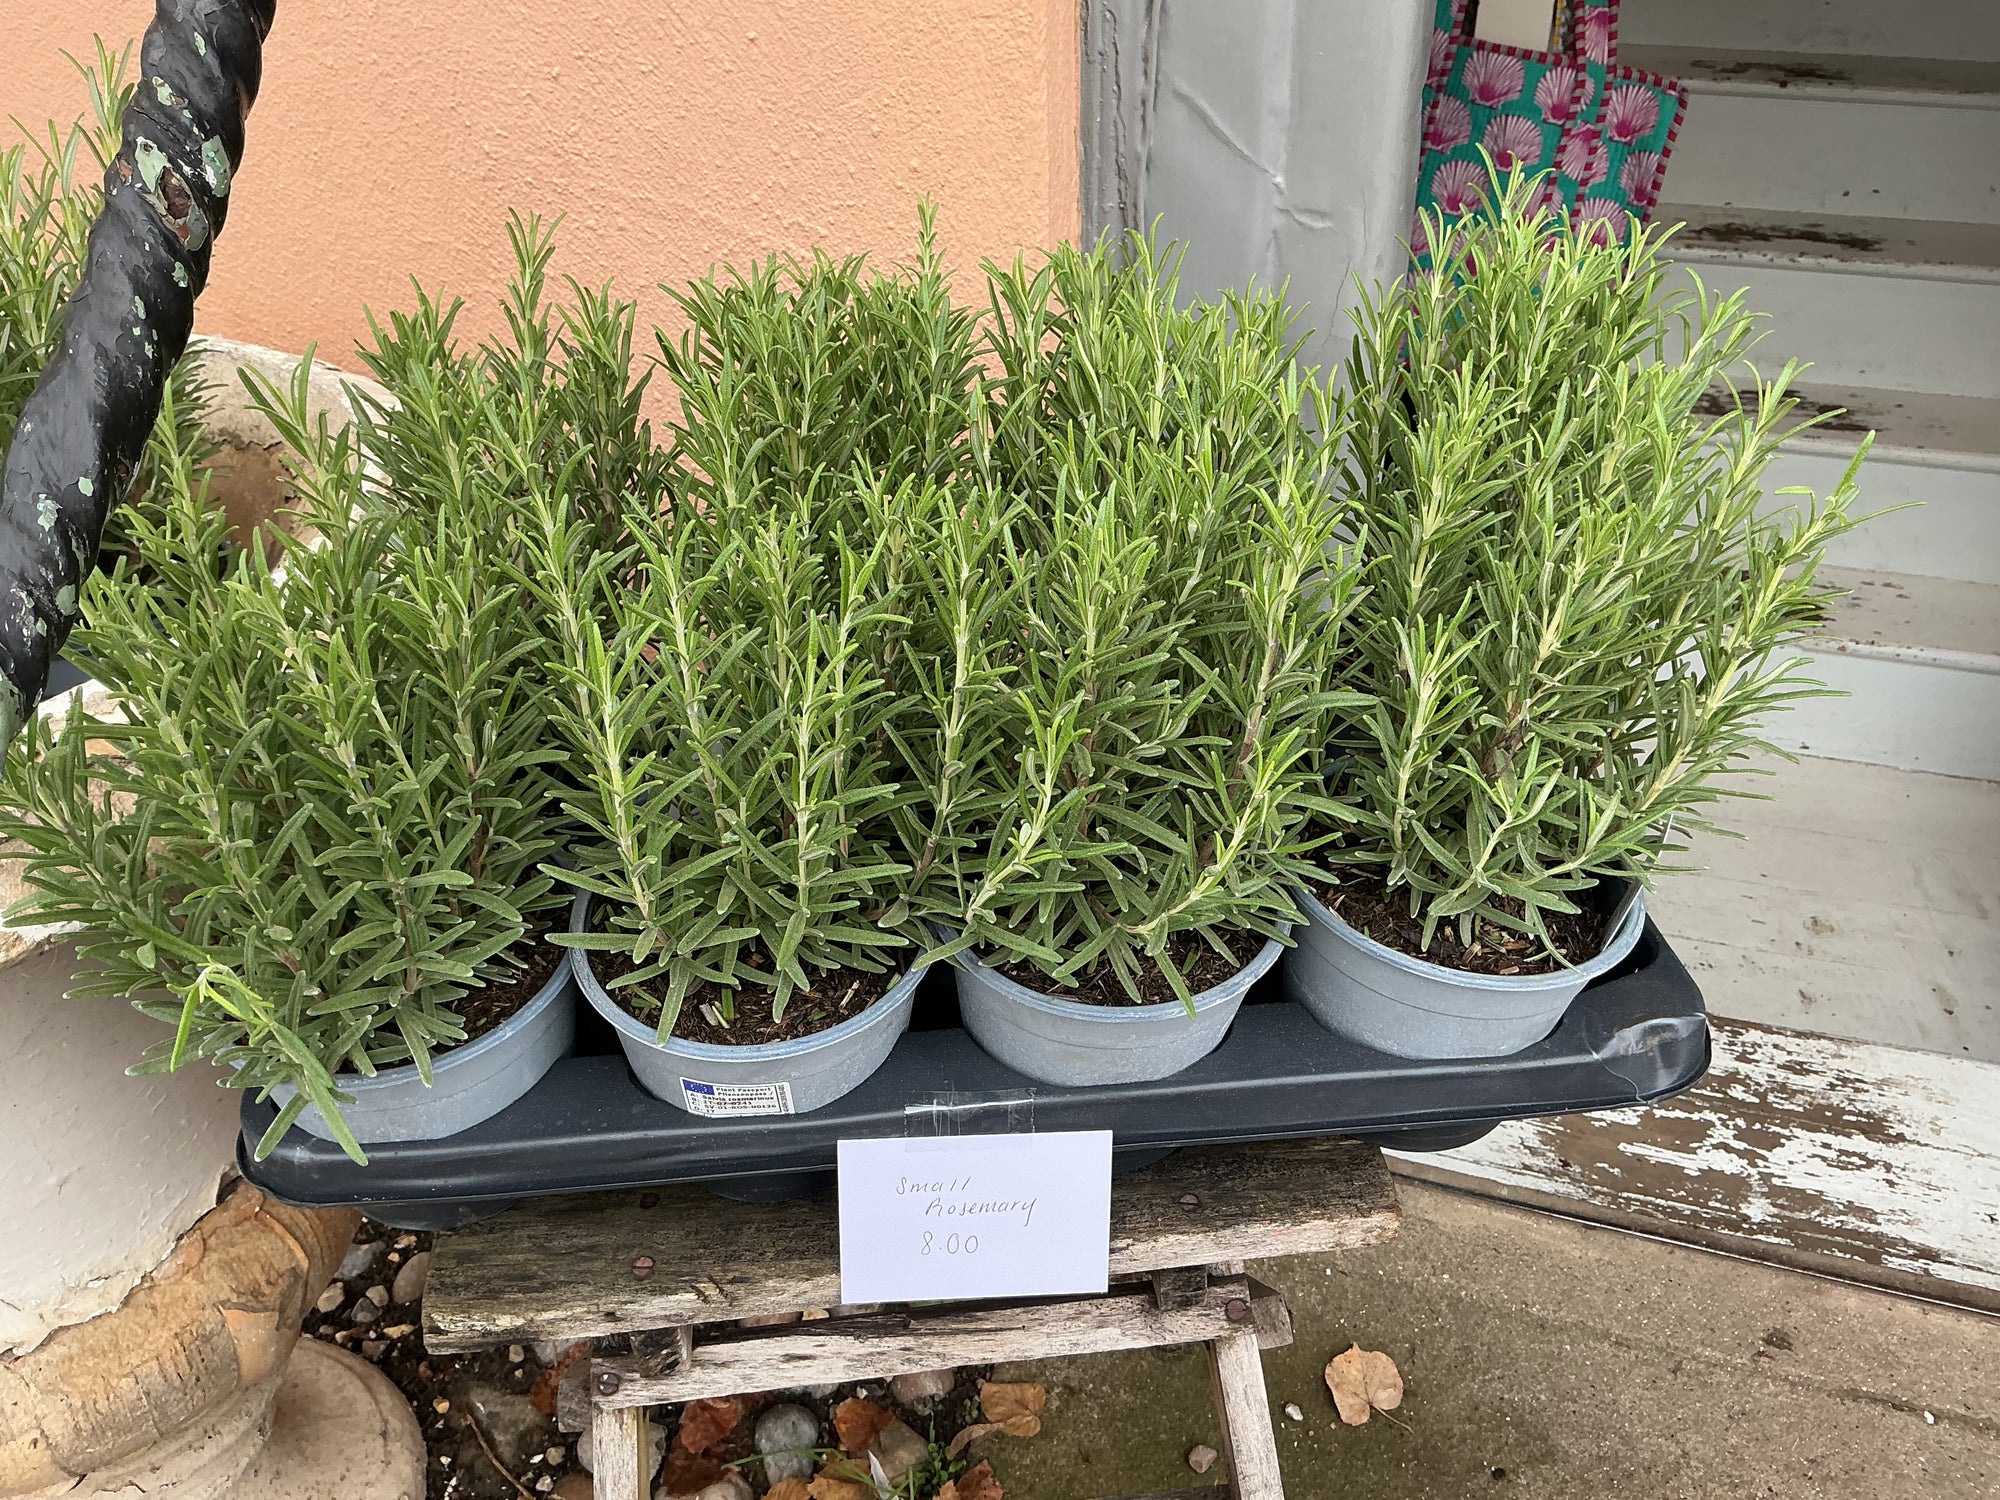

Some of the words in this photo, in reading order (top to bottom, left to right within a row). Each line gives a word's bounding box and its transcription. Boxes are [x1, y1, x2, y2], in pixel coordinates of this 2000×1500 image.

[896, 1176, 972, 1195] Small
[925, 1197, 1038, 1227] Rosemary
[920, 1230, 979, 1256] 8.00
